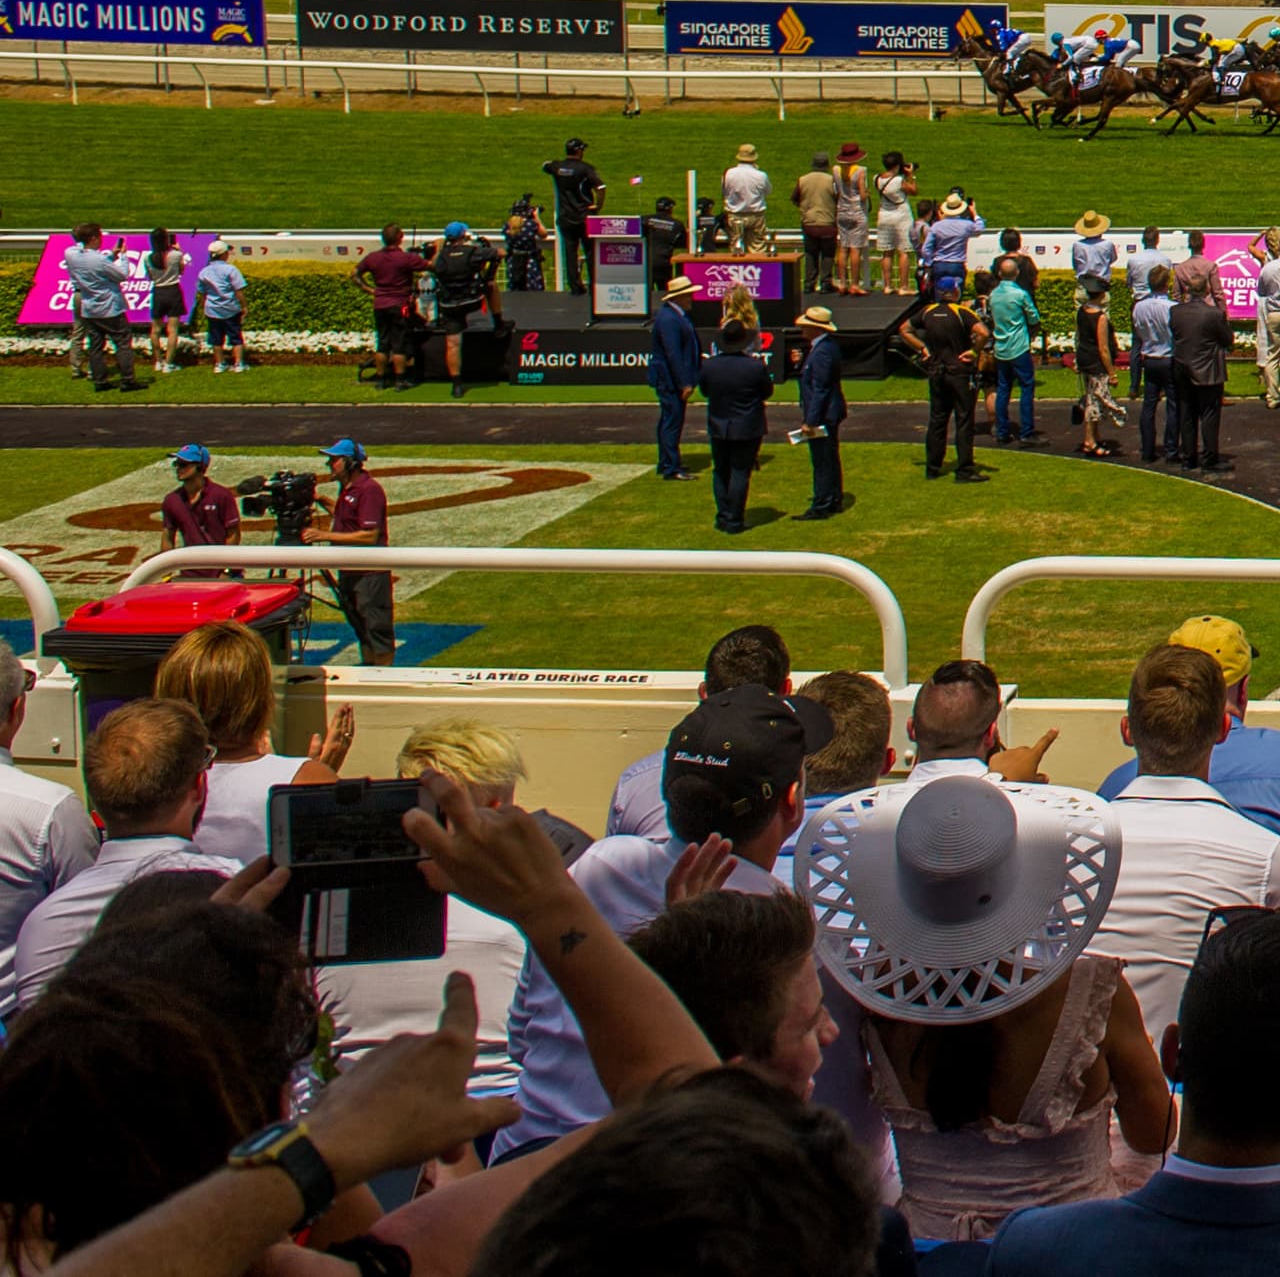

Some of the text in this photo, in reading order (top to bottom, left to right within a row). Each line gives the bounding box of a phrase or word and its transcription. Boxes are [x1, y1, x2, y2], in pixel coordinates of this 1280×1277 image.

[18, 1, 205, 33] MAGIC MILLIONS
[217, 8, 247, 17] MAGIC
[307, 11, 611, 35] WOODFORD RESERVE
[680, 22, 771, 35] SINGAPORE
[858, 25, 949, 39] SINGAPORE
[698, 35, 771, 47] AIRLINES
[876, 38, 949, 50] AIRLINES
[1225, 74, 1242, 89] 10
[729, 265, 763, 281] SKY
[520, 353, 653, 367] MAGIC MILLION
[534, 673, 600, 683] DURING
[604, 674, 649, 683] RACE
